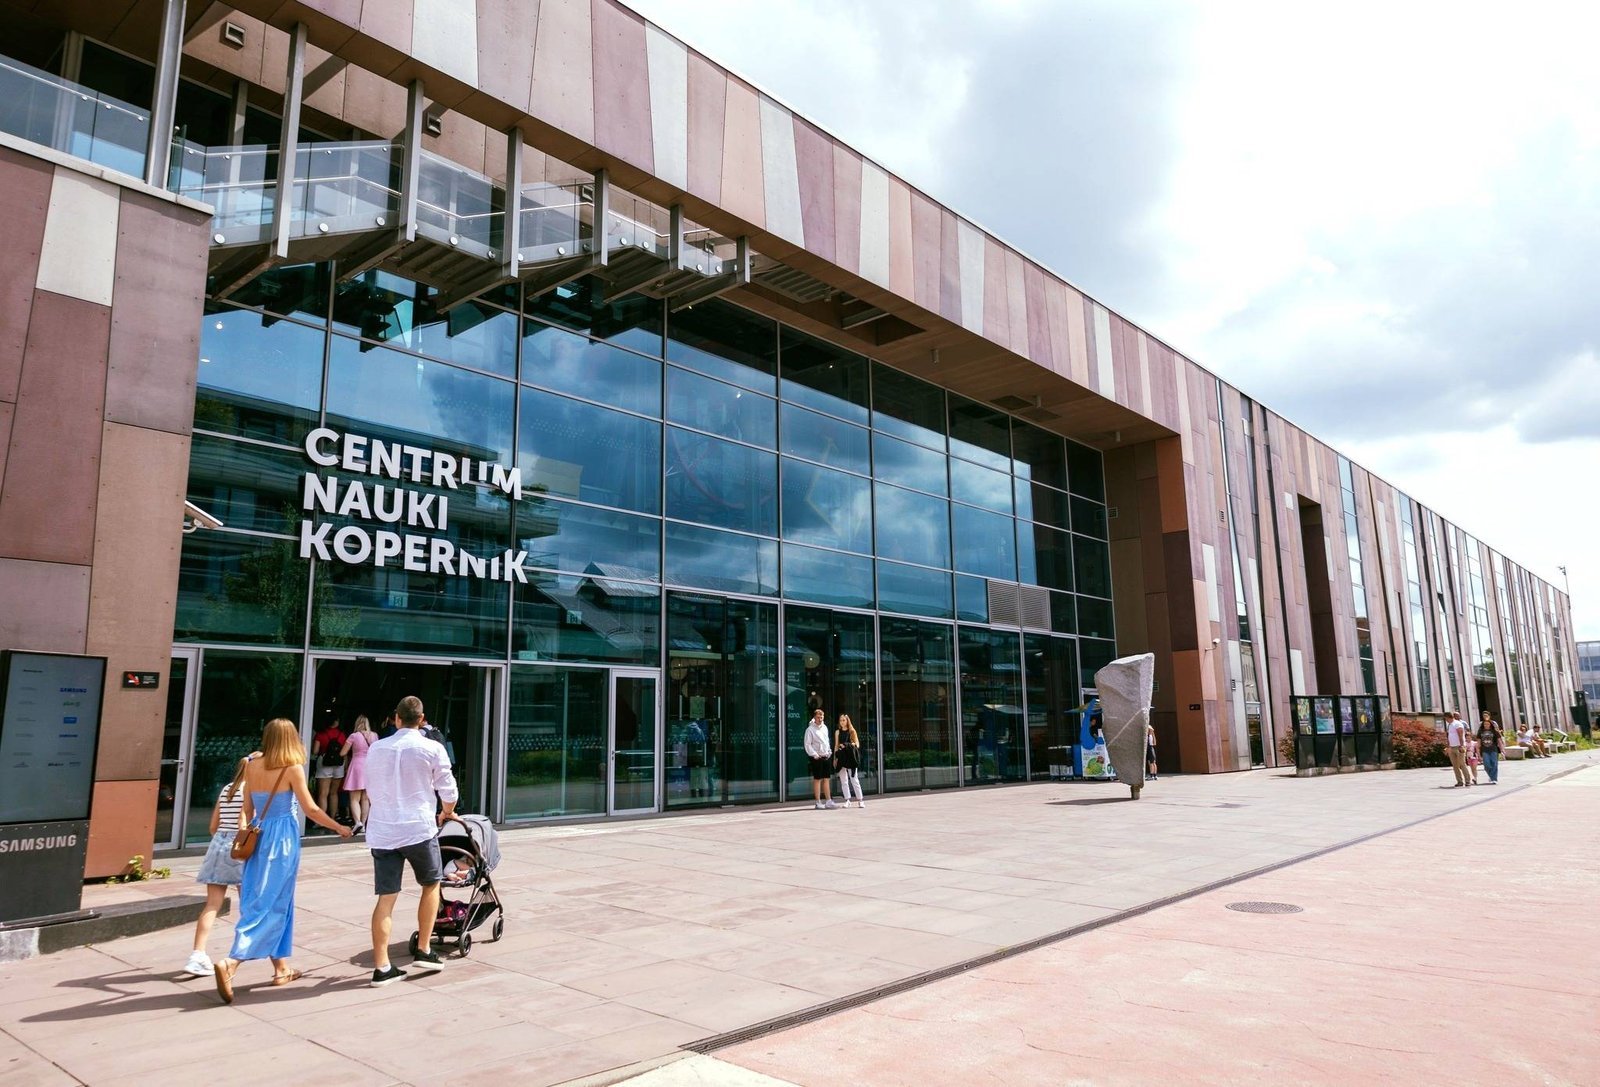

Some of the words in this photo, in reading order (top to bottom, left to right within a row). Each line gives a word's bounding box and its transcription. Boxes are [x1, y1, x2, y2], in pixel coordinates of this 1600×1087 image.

[305, 427, 522, 500] CENTRUM
[303, 472, 448, 531] NAUKI
[300, 519, 529, 584] KOPERNIK
[0, 834, 77, 853] SAMSUNG
